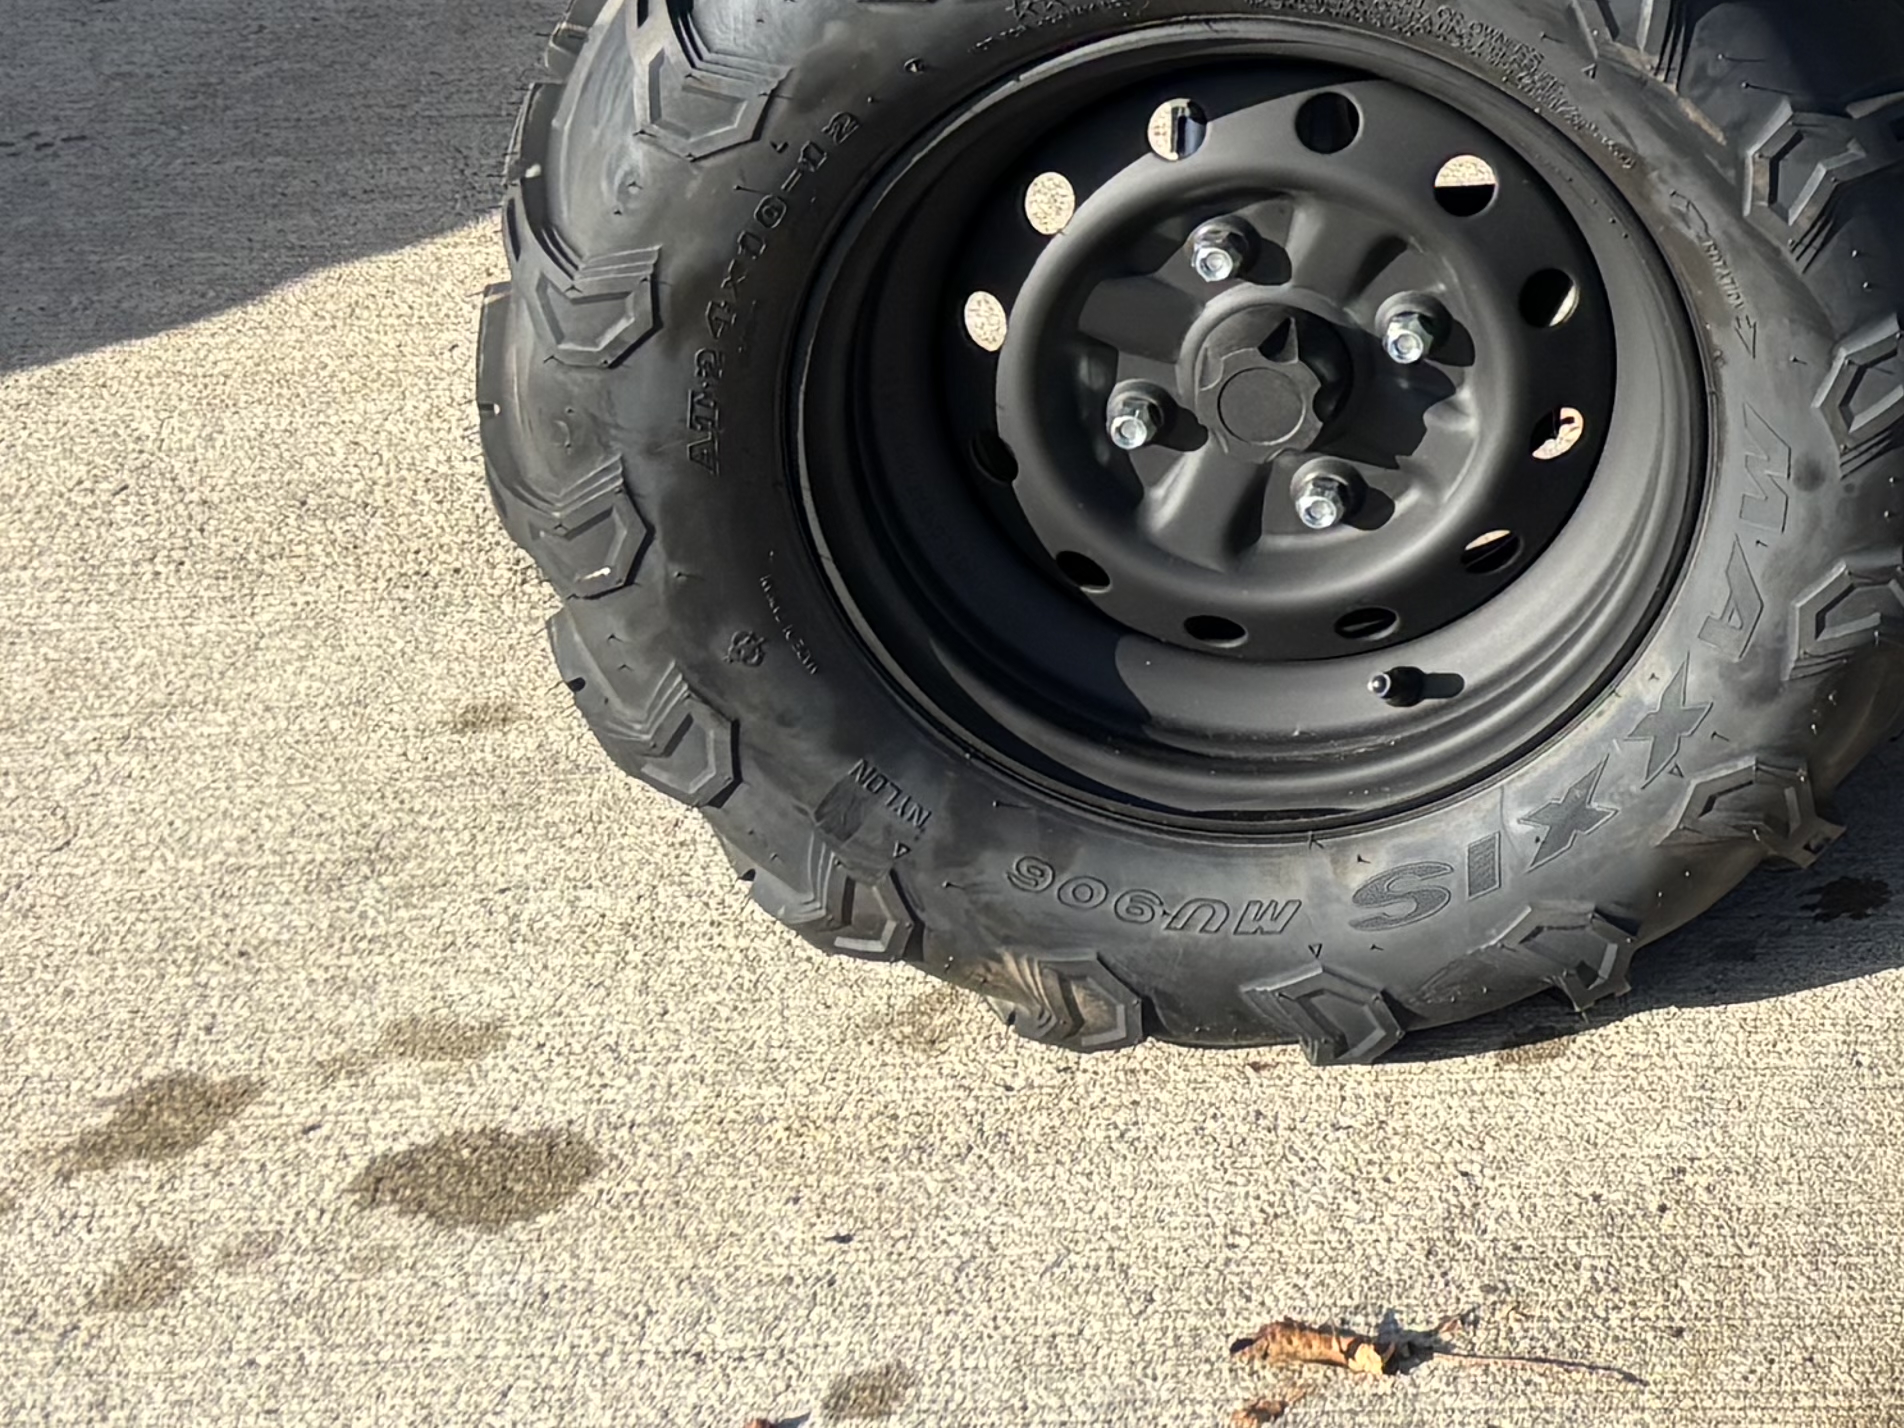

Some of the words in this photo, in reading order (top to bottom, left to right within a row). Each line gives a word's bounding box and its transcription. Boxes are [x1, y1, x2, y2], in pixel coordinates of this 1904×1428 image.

[1348, 401, 1792, 933] MAXXIS
[847, 757, 933, 828] NYLON
[1006, 855, 1303, 936] MU906
